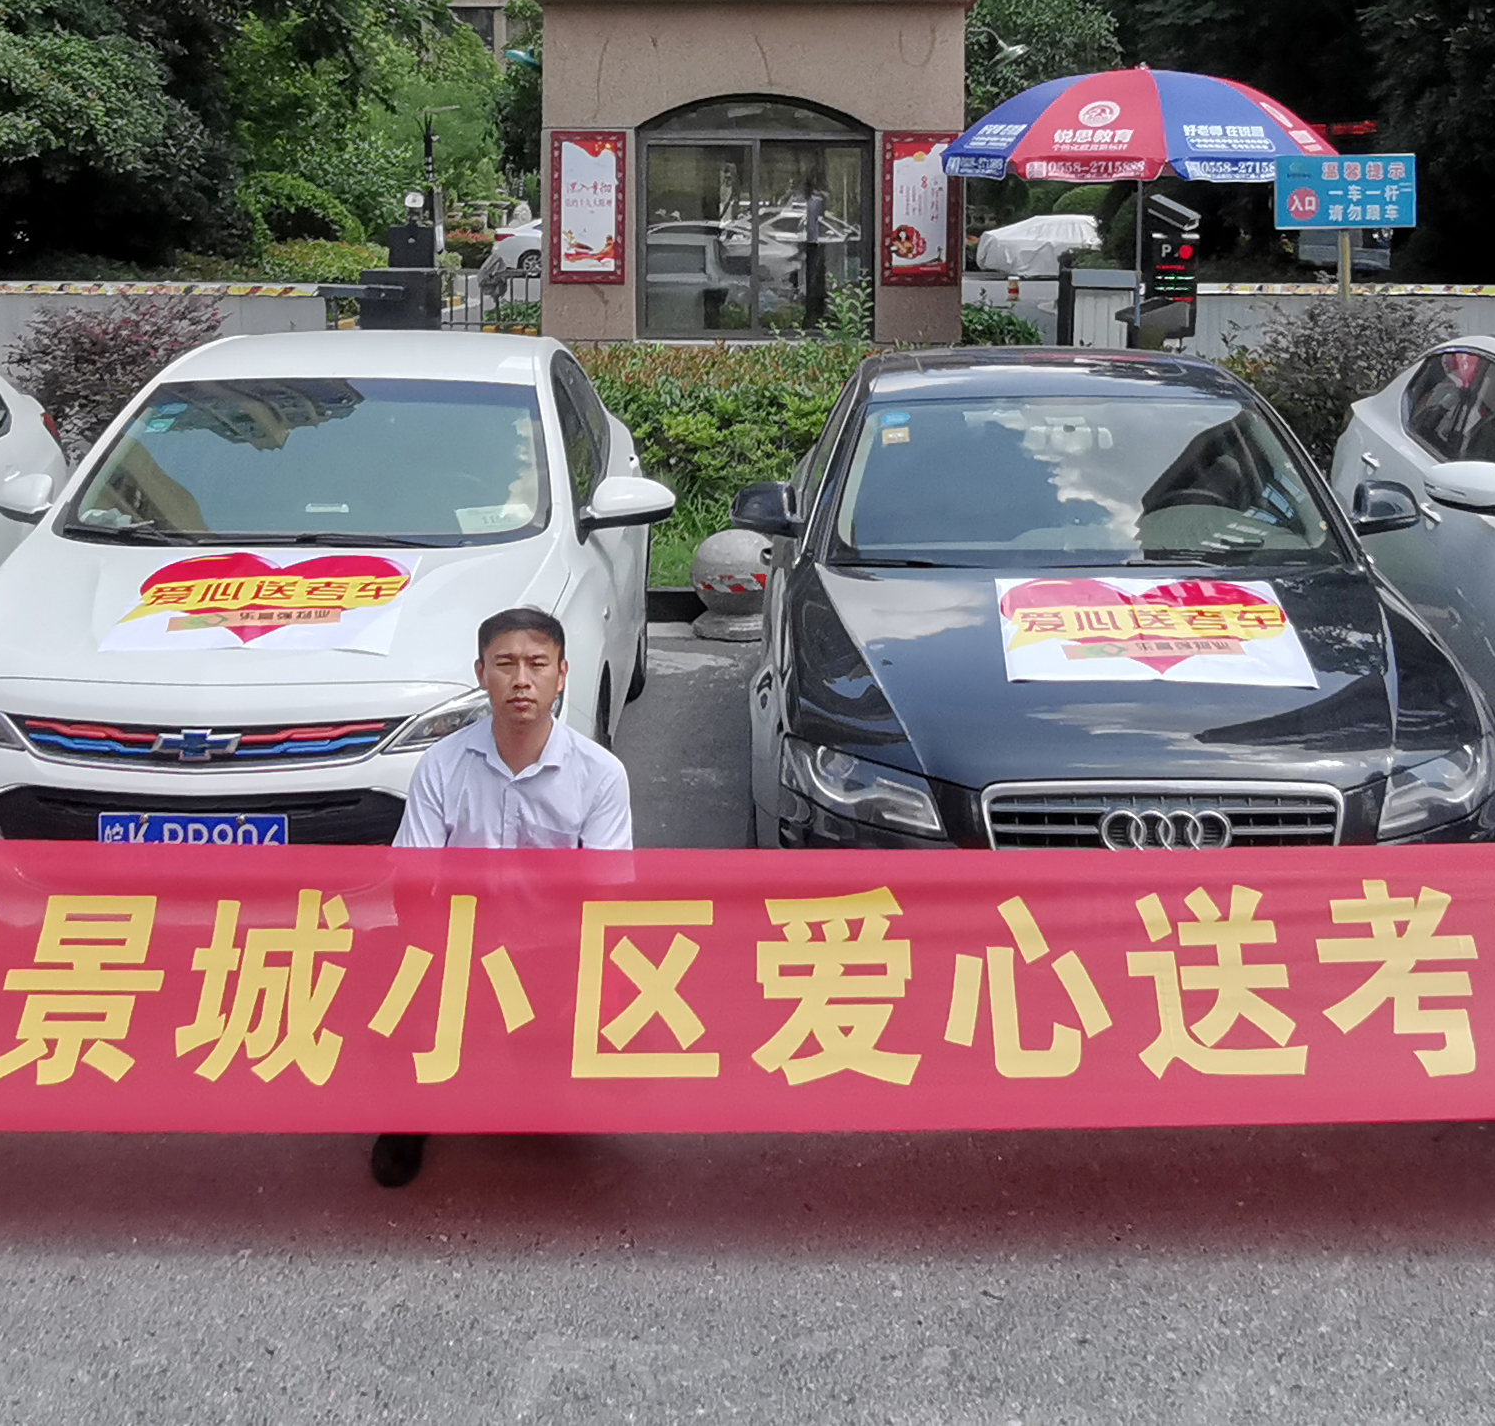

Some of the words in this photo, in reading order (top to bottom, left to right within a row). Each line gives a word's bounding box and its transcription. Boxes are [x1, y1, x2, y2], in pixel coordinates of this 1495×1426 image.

[1290, 195, 1316, 212] 入口
[1328, 184, 1400, 202] 一车一杆
[149, 577, 403, 605] 爱心送考车
[1020, 608, 1284, 633] 爱心送考车
